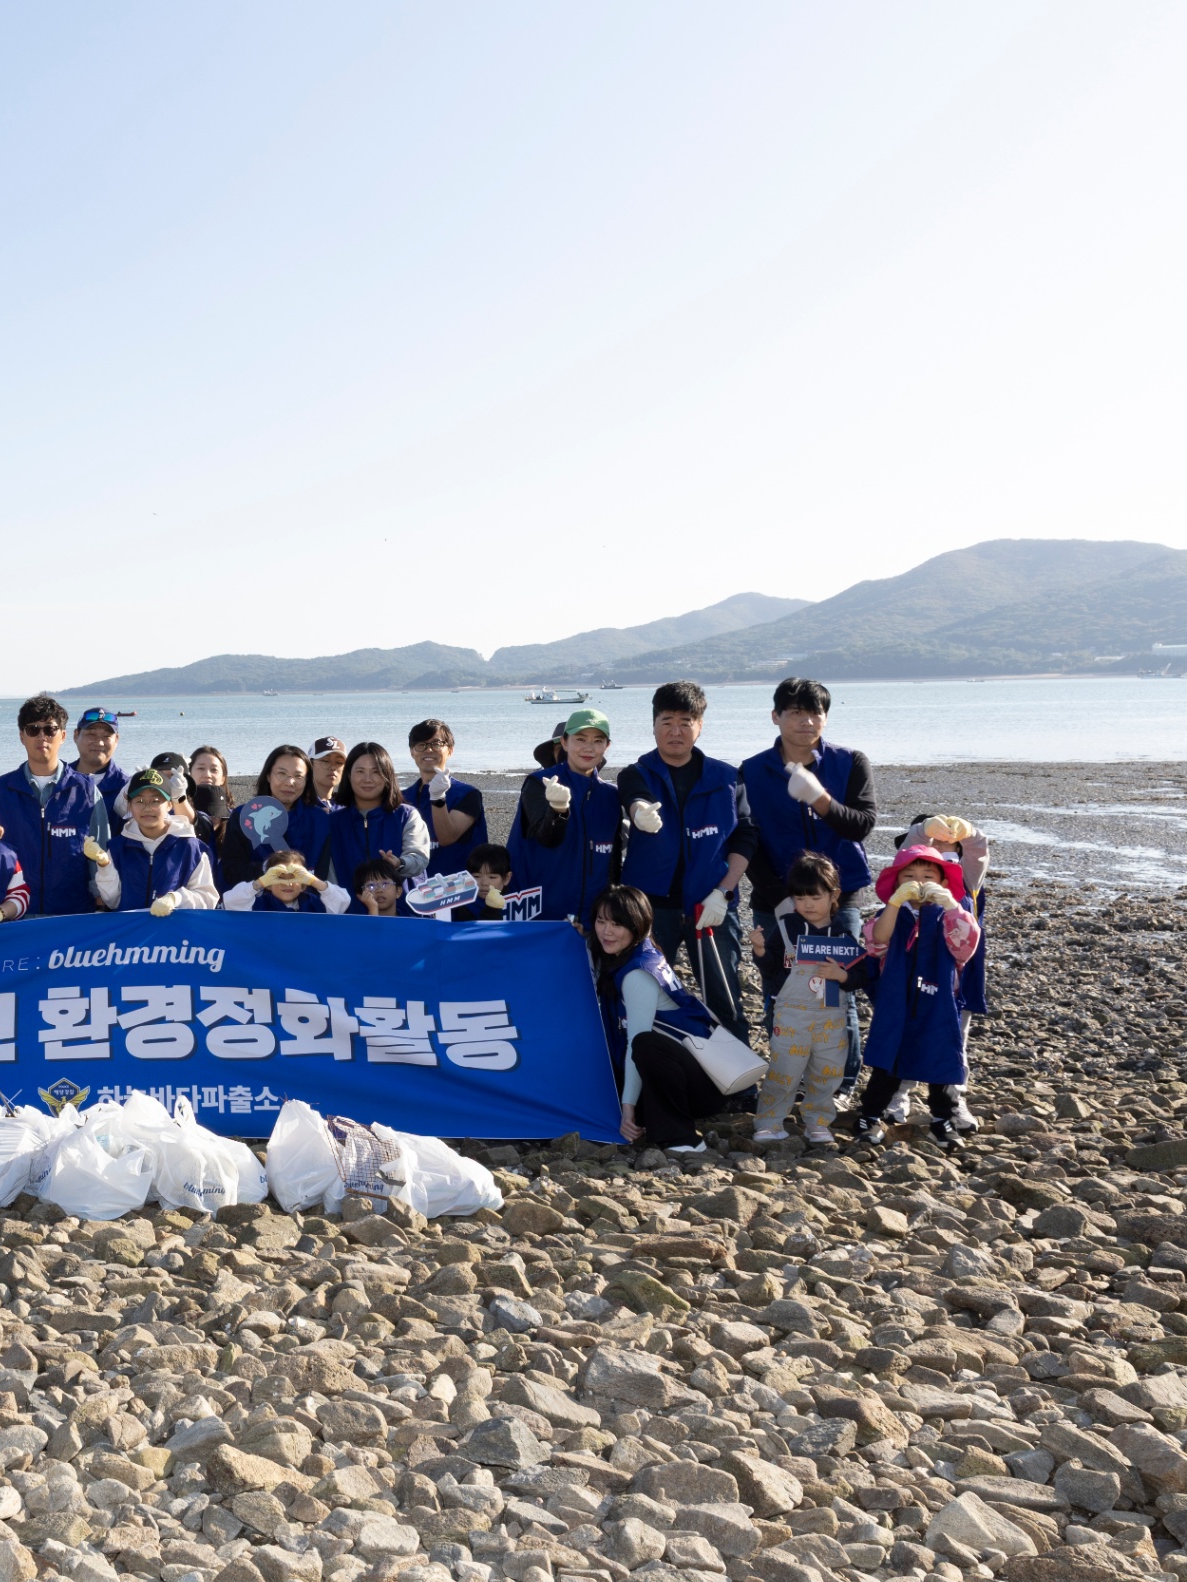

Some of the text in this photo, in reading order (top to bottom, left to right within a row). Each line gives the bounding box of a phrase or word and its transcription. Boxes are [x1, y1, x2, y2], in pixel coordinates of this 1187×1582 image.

[51, 827, 76, 837] HMM
[691, 826, 719, 839] HMM
[440, 895, 461, 906] HMM
[800, 944, 814, 954] WE
[815, 944, 832, 955] ARE
[48, 940, 226, 973] bluehmming
[38, 985, 519, 1071] 환경정화활동
